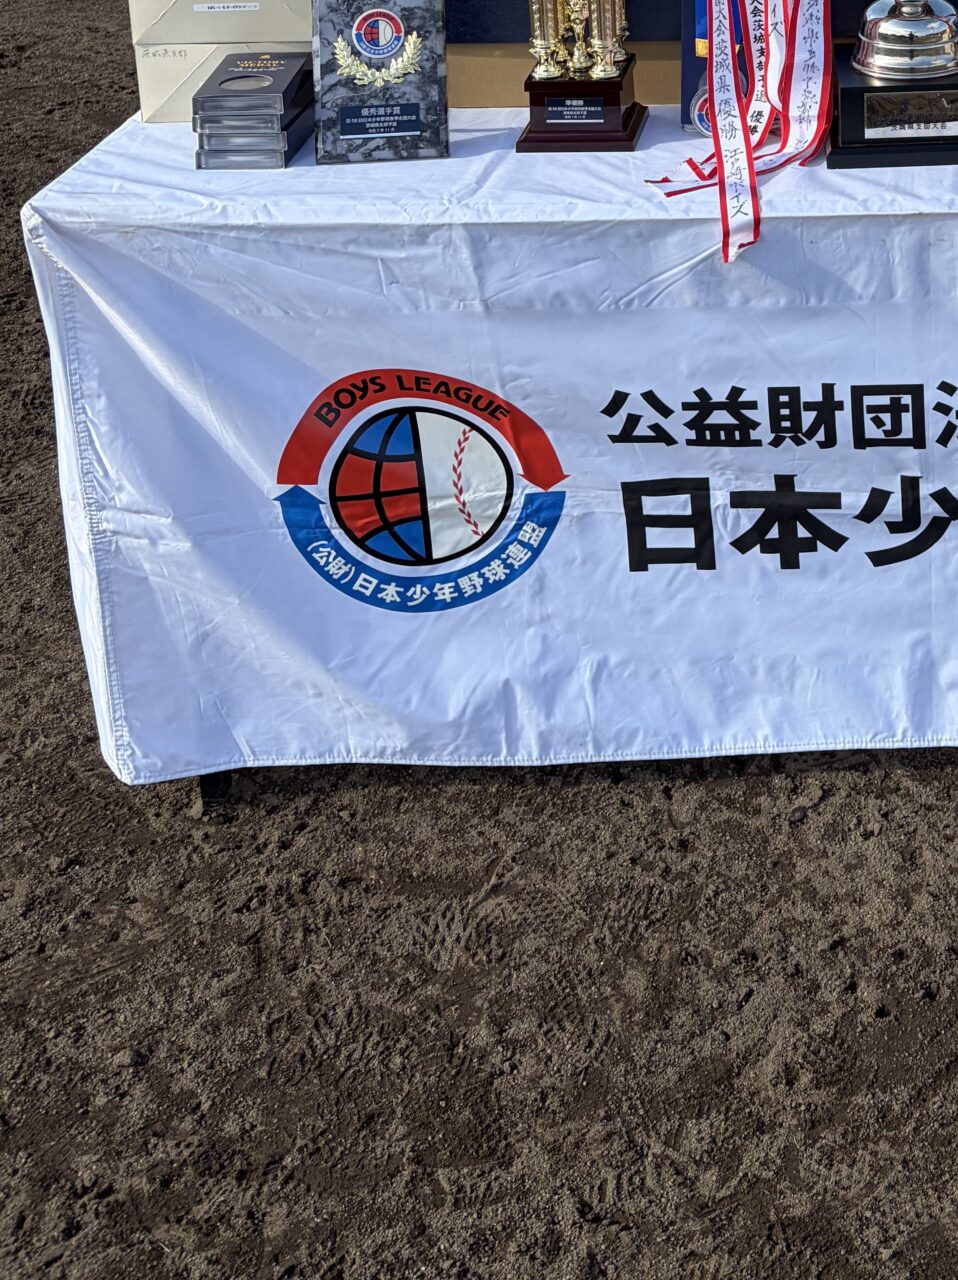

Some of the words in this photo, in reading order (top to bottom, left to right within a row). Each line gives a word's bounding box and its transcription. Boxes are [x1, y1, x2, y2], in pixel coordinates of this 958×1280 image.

[716, 98, 740, 141] 優勝
[313, 374, 387, 429] BOYS
[395, 374, 511, 422] LEAGUE
[305, 520, 549, 607] (公財)日本少年野球連盟
